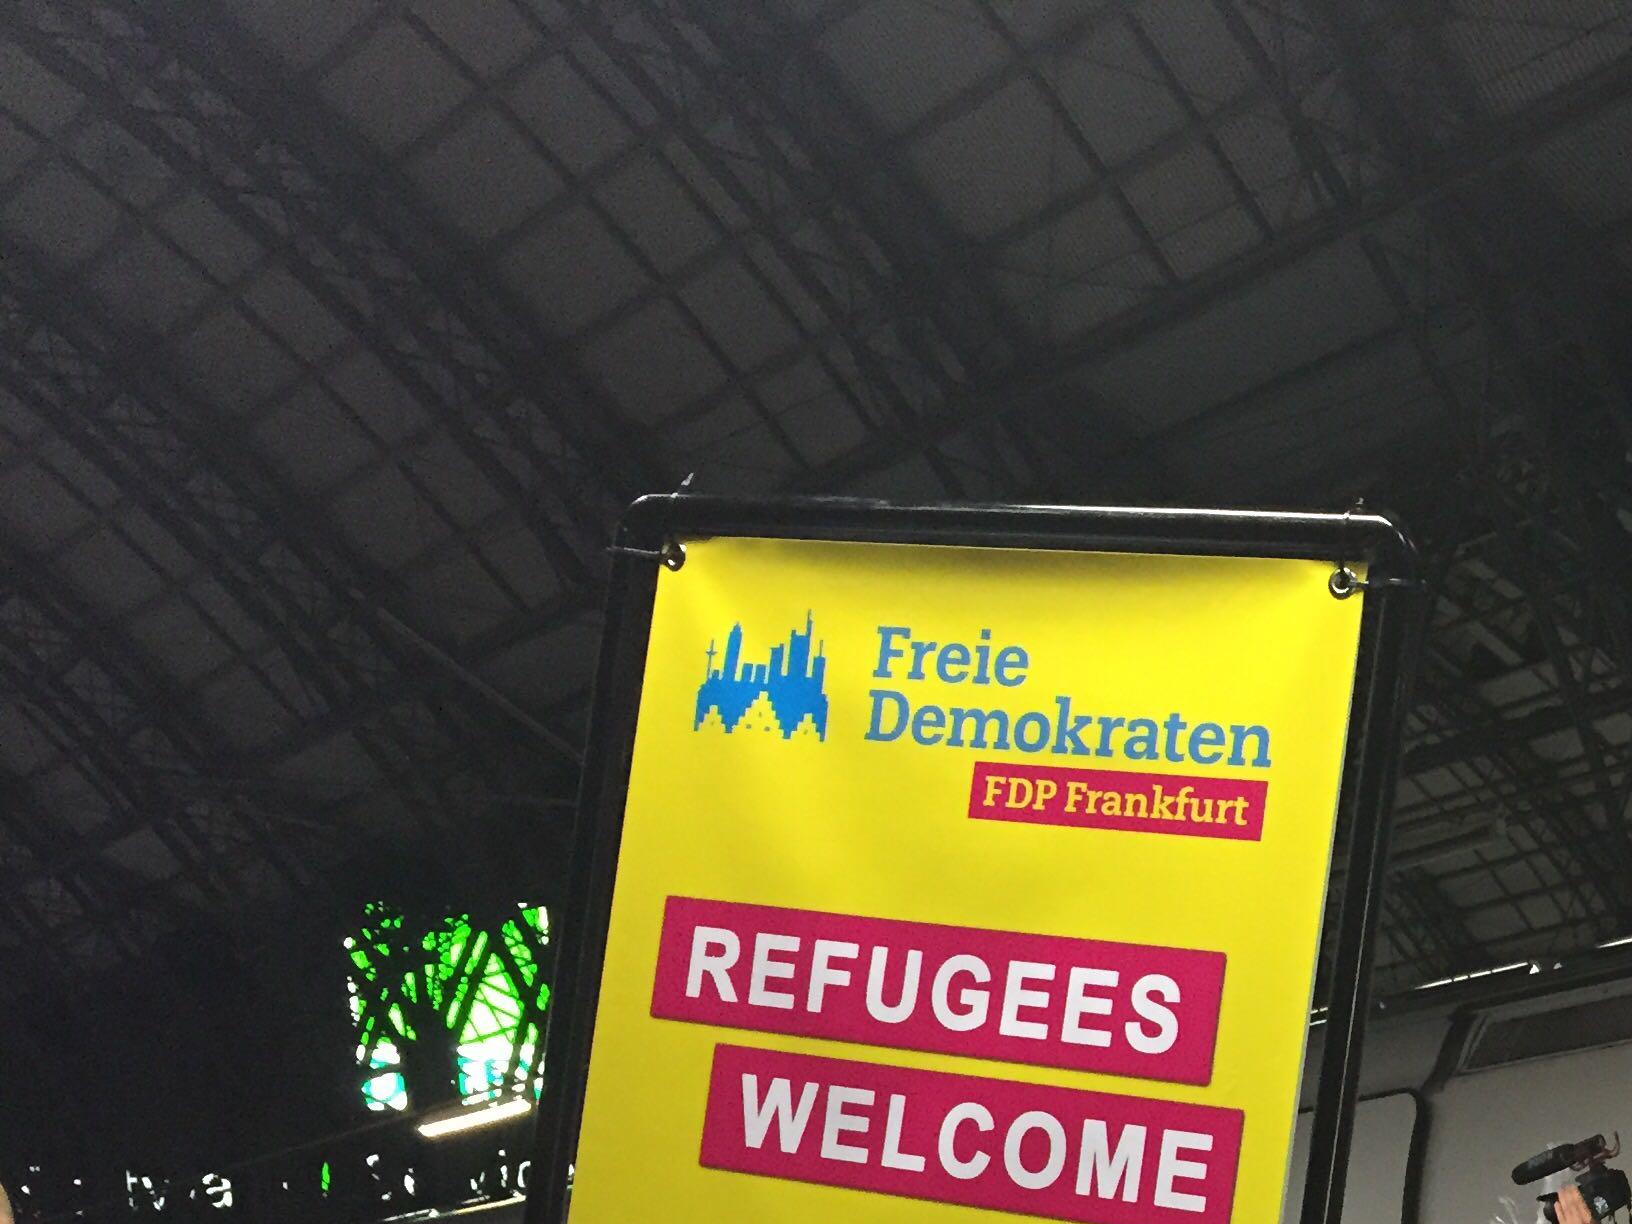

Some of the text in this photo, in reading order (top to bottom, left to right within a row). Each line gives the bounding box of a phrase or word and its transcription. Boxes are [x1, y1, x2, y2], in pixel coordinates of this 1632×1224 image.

[871, 625, 1030, 688] Freie
[864, 689, 1272, 768] Demokraten
[982, 776, 1249, 828] FDP Frankfurt
[685, 925, 1182, 1055] REFUGEES
[741, 1073, 1215, 1213] WELCOME
